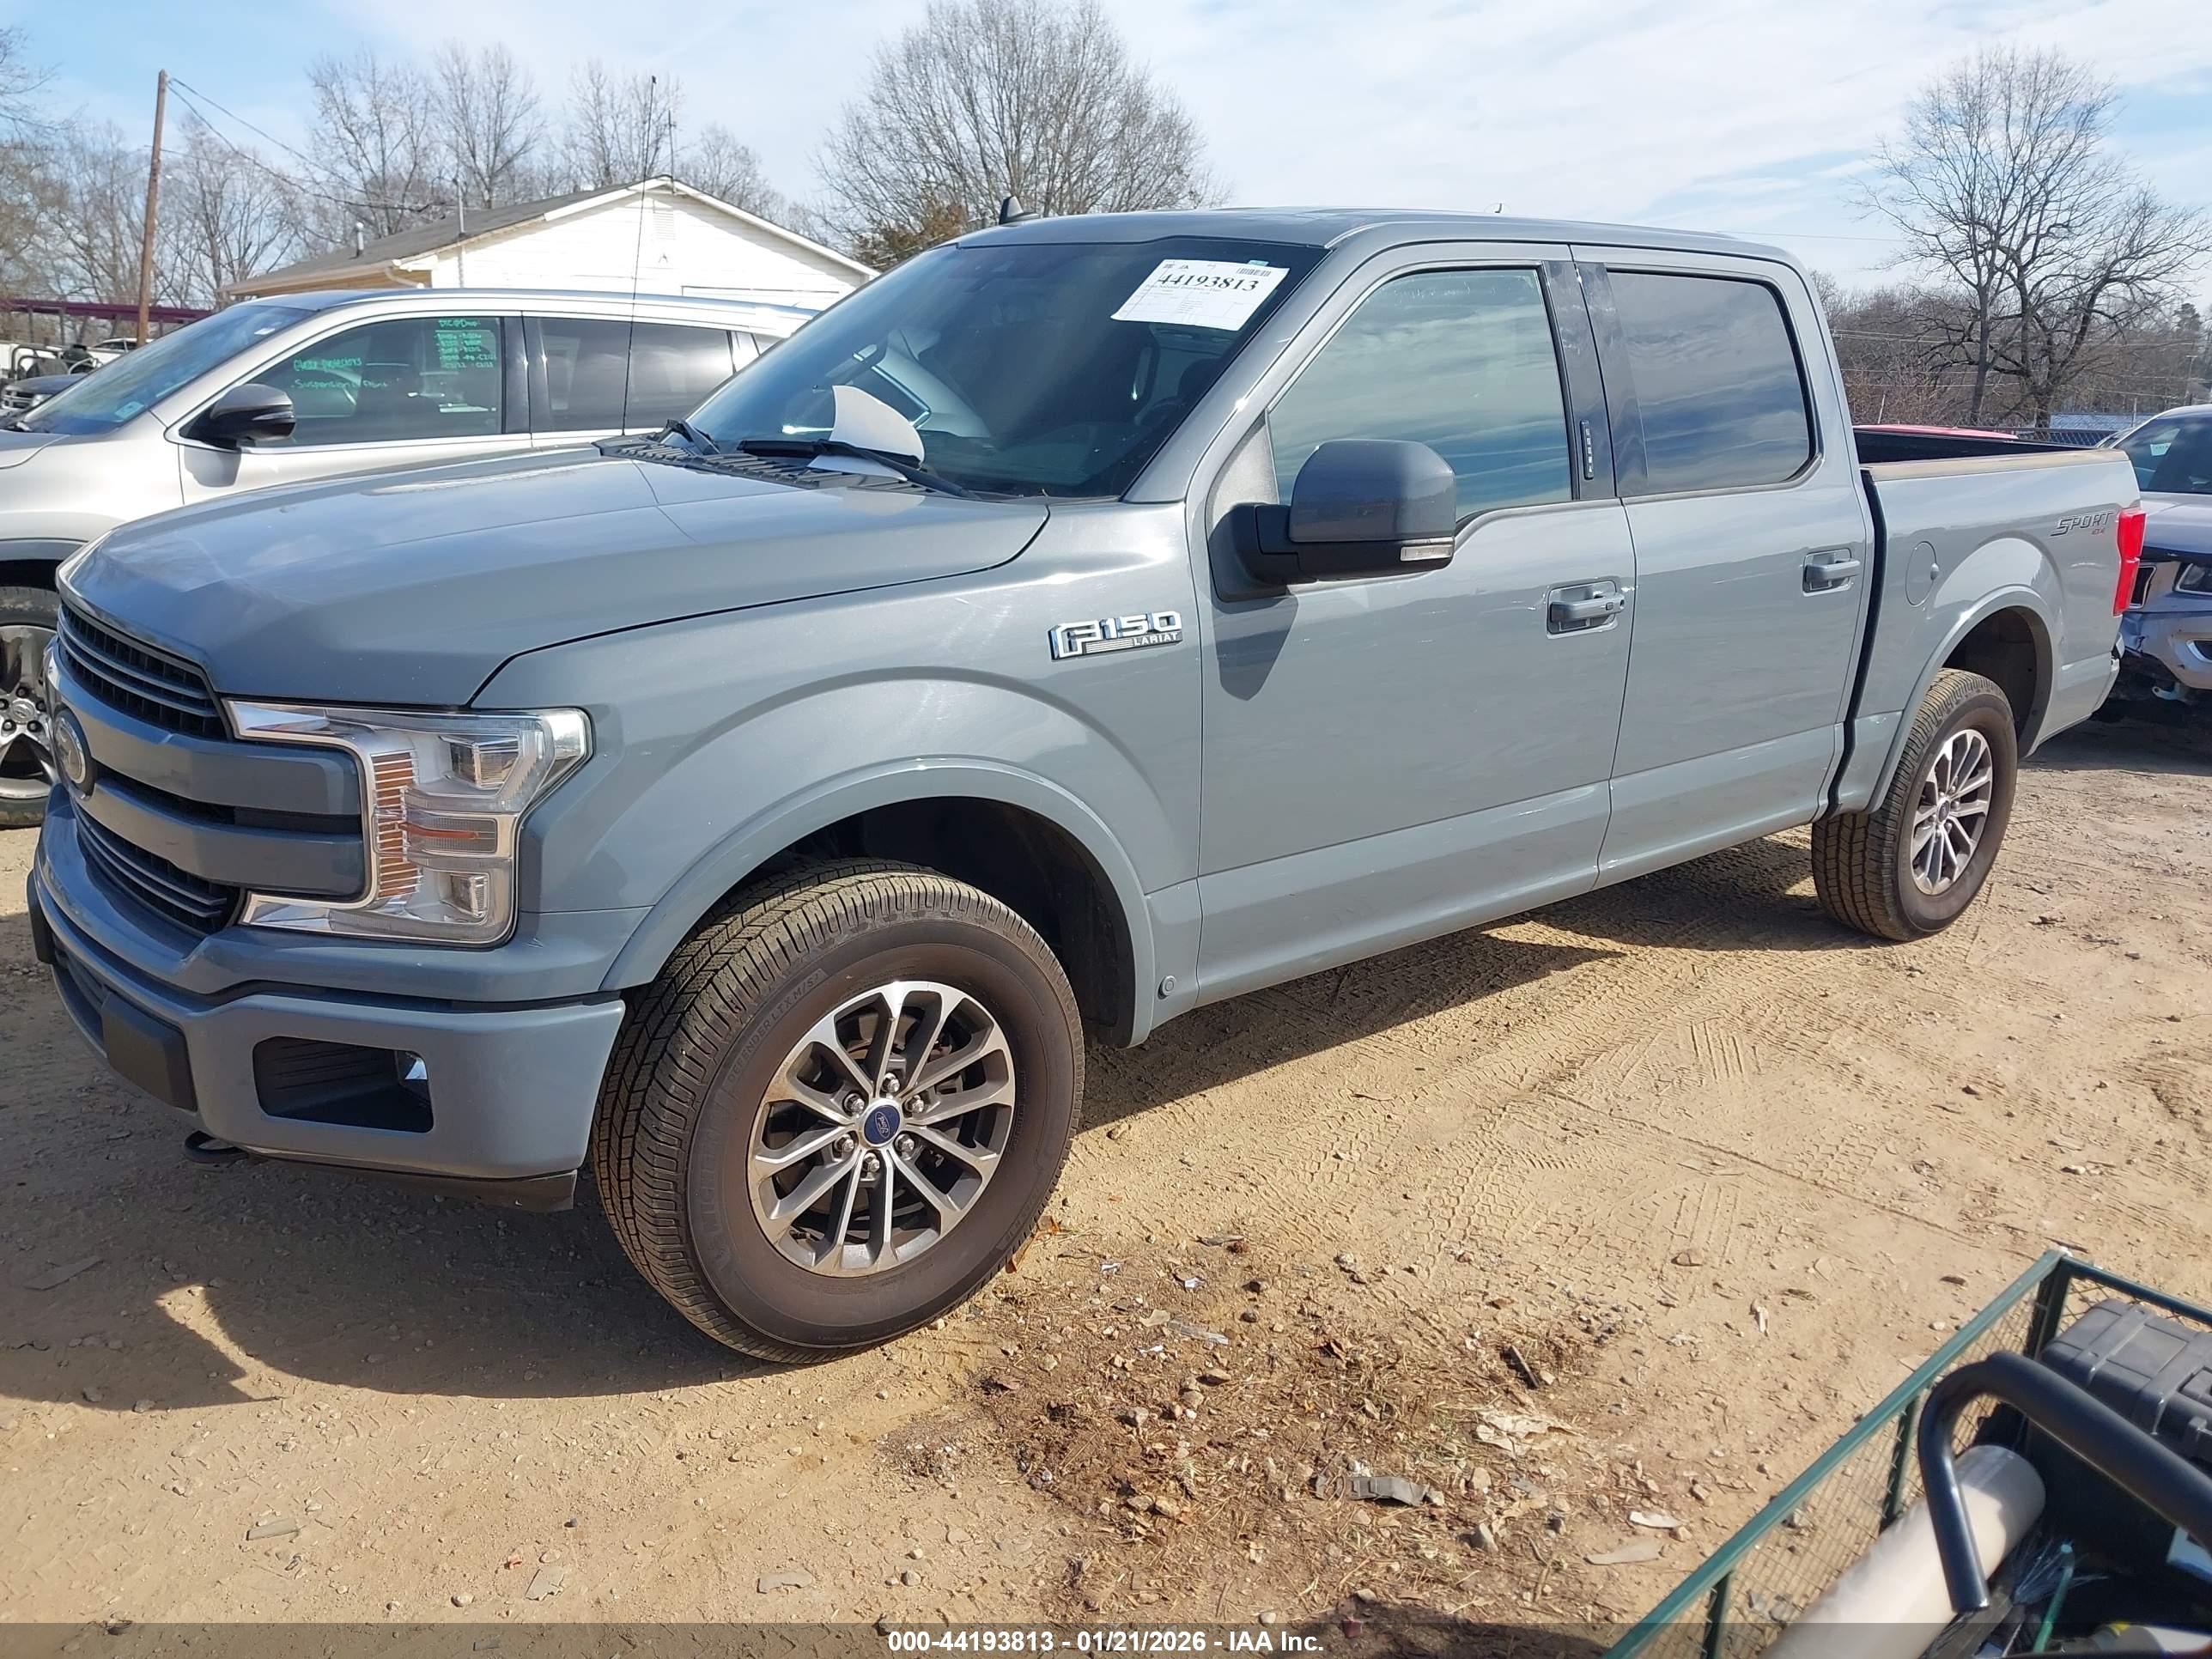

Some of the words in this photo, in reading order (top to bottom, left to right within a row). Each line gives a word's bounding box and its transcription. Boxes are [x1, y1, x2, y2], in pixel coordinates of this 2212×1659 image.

[1158, 273, 1259, 292] 44193813
[2050, 511, 2114, 537] SPORT
[1133, 631, 1180, 647] LARIAT
[727, 1020, 772, 1083] DEFENDER
